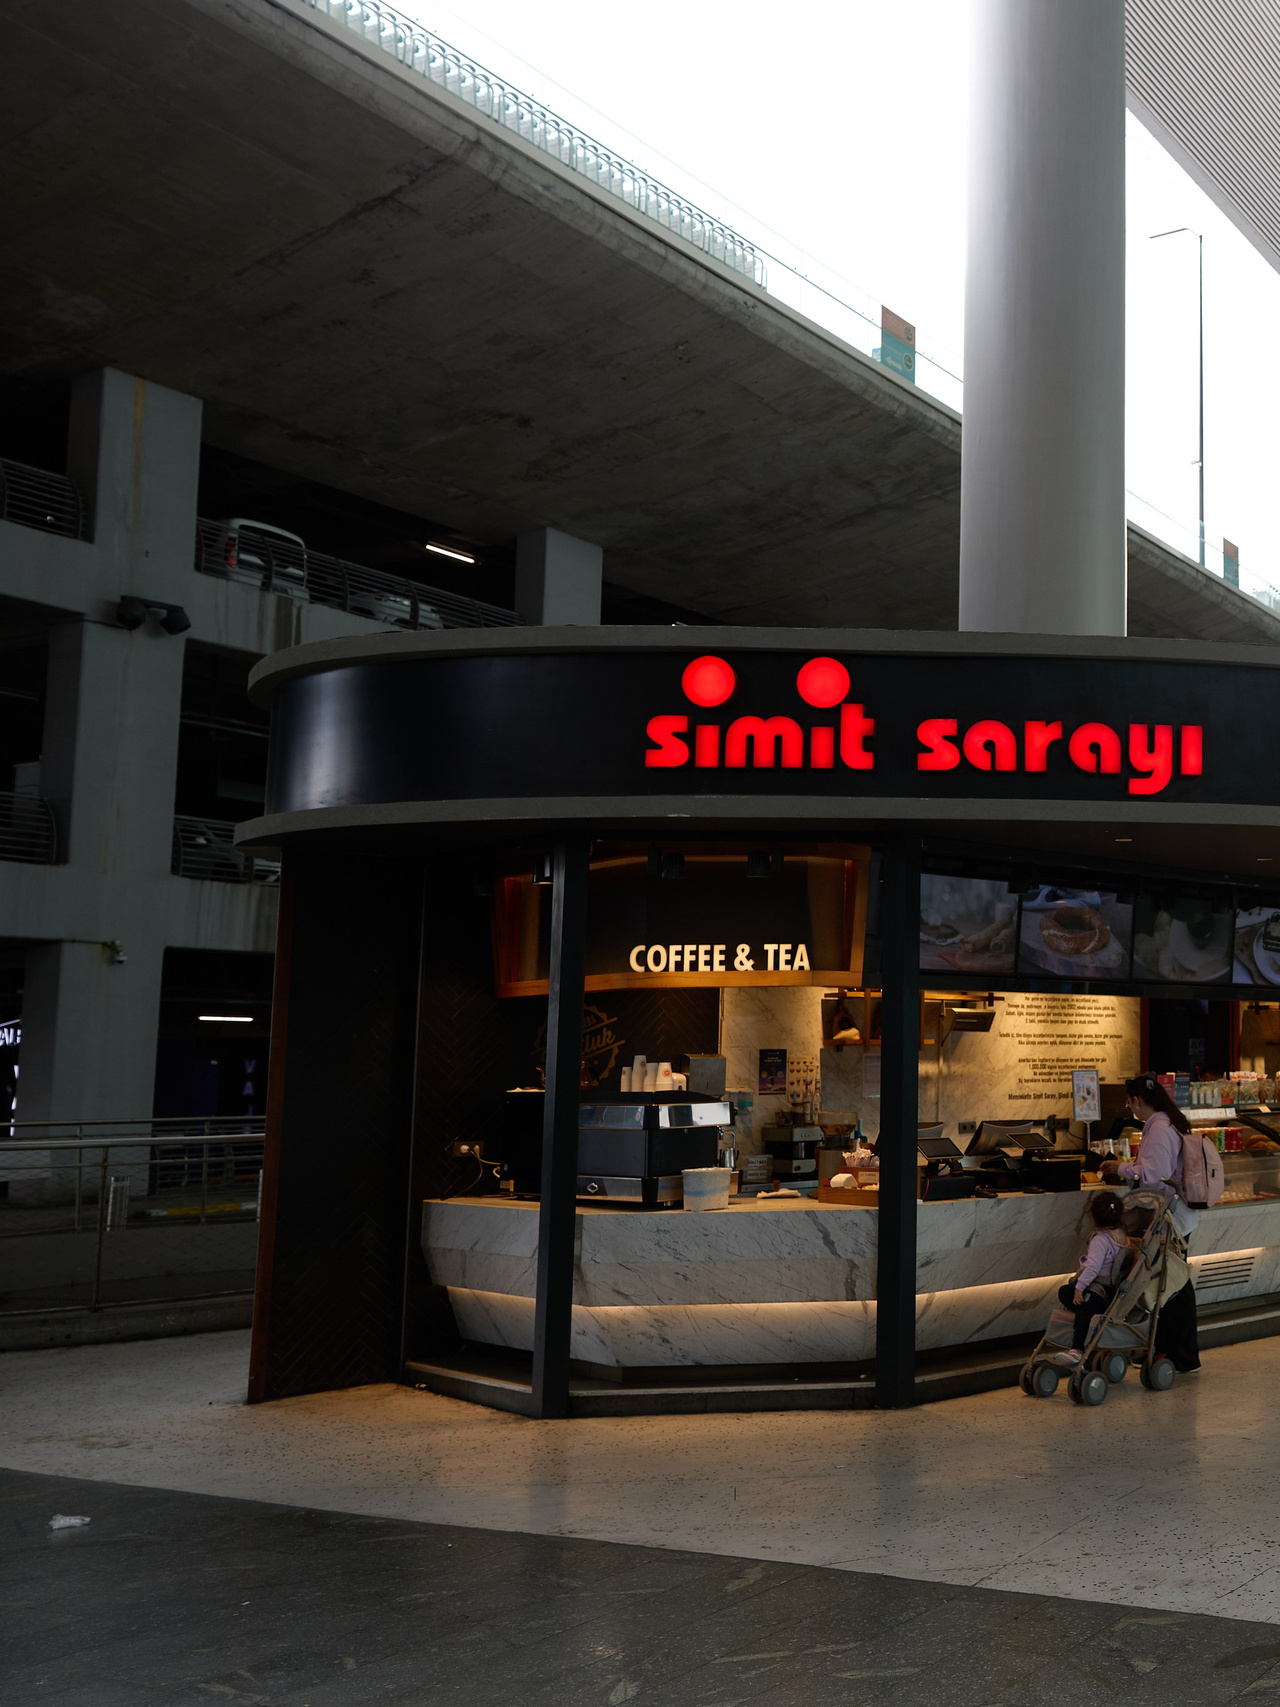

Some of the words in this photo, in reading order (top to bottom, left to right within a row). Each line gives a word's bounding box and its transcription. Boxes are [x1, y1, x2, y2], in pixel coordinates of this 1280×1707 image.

[645, 655, 875, 771] simit
[917, 718, 1203, 795] sarayı
[629, 944, 726, 973] COFFEE
[733, 943, 756, 972] &
[763, 943, 811, 971] TEA
